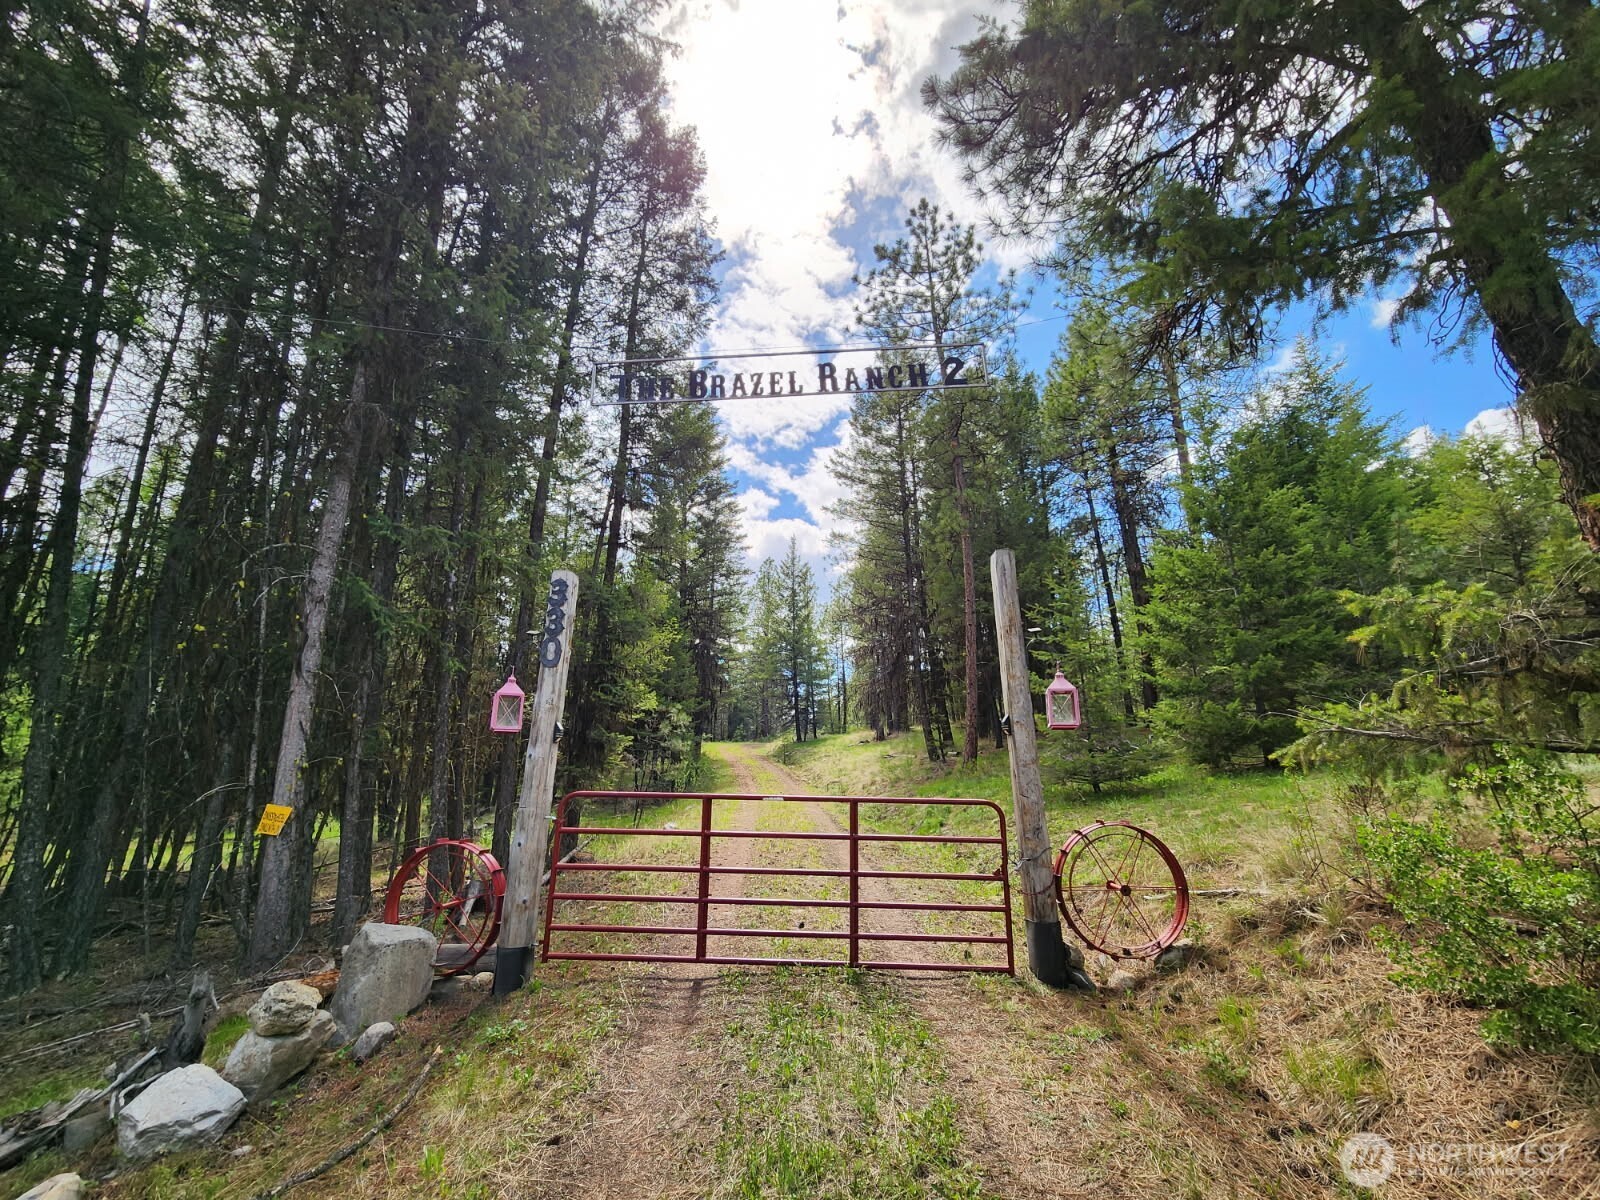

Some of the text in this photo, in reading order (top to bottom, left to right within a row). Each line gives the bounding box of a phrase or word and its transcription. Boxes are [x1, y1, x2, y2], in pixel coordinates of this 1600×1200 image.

[689, 369, 804, 400] BRAZEL
[817, 361, 929, 393] RANCH
[941, 356, 968, 386] 2
[541, 578, 569, 669] 330
